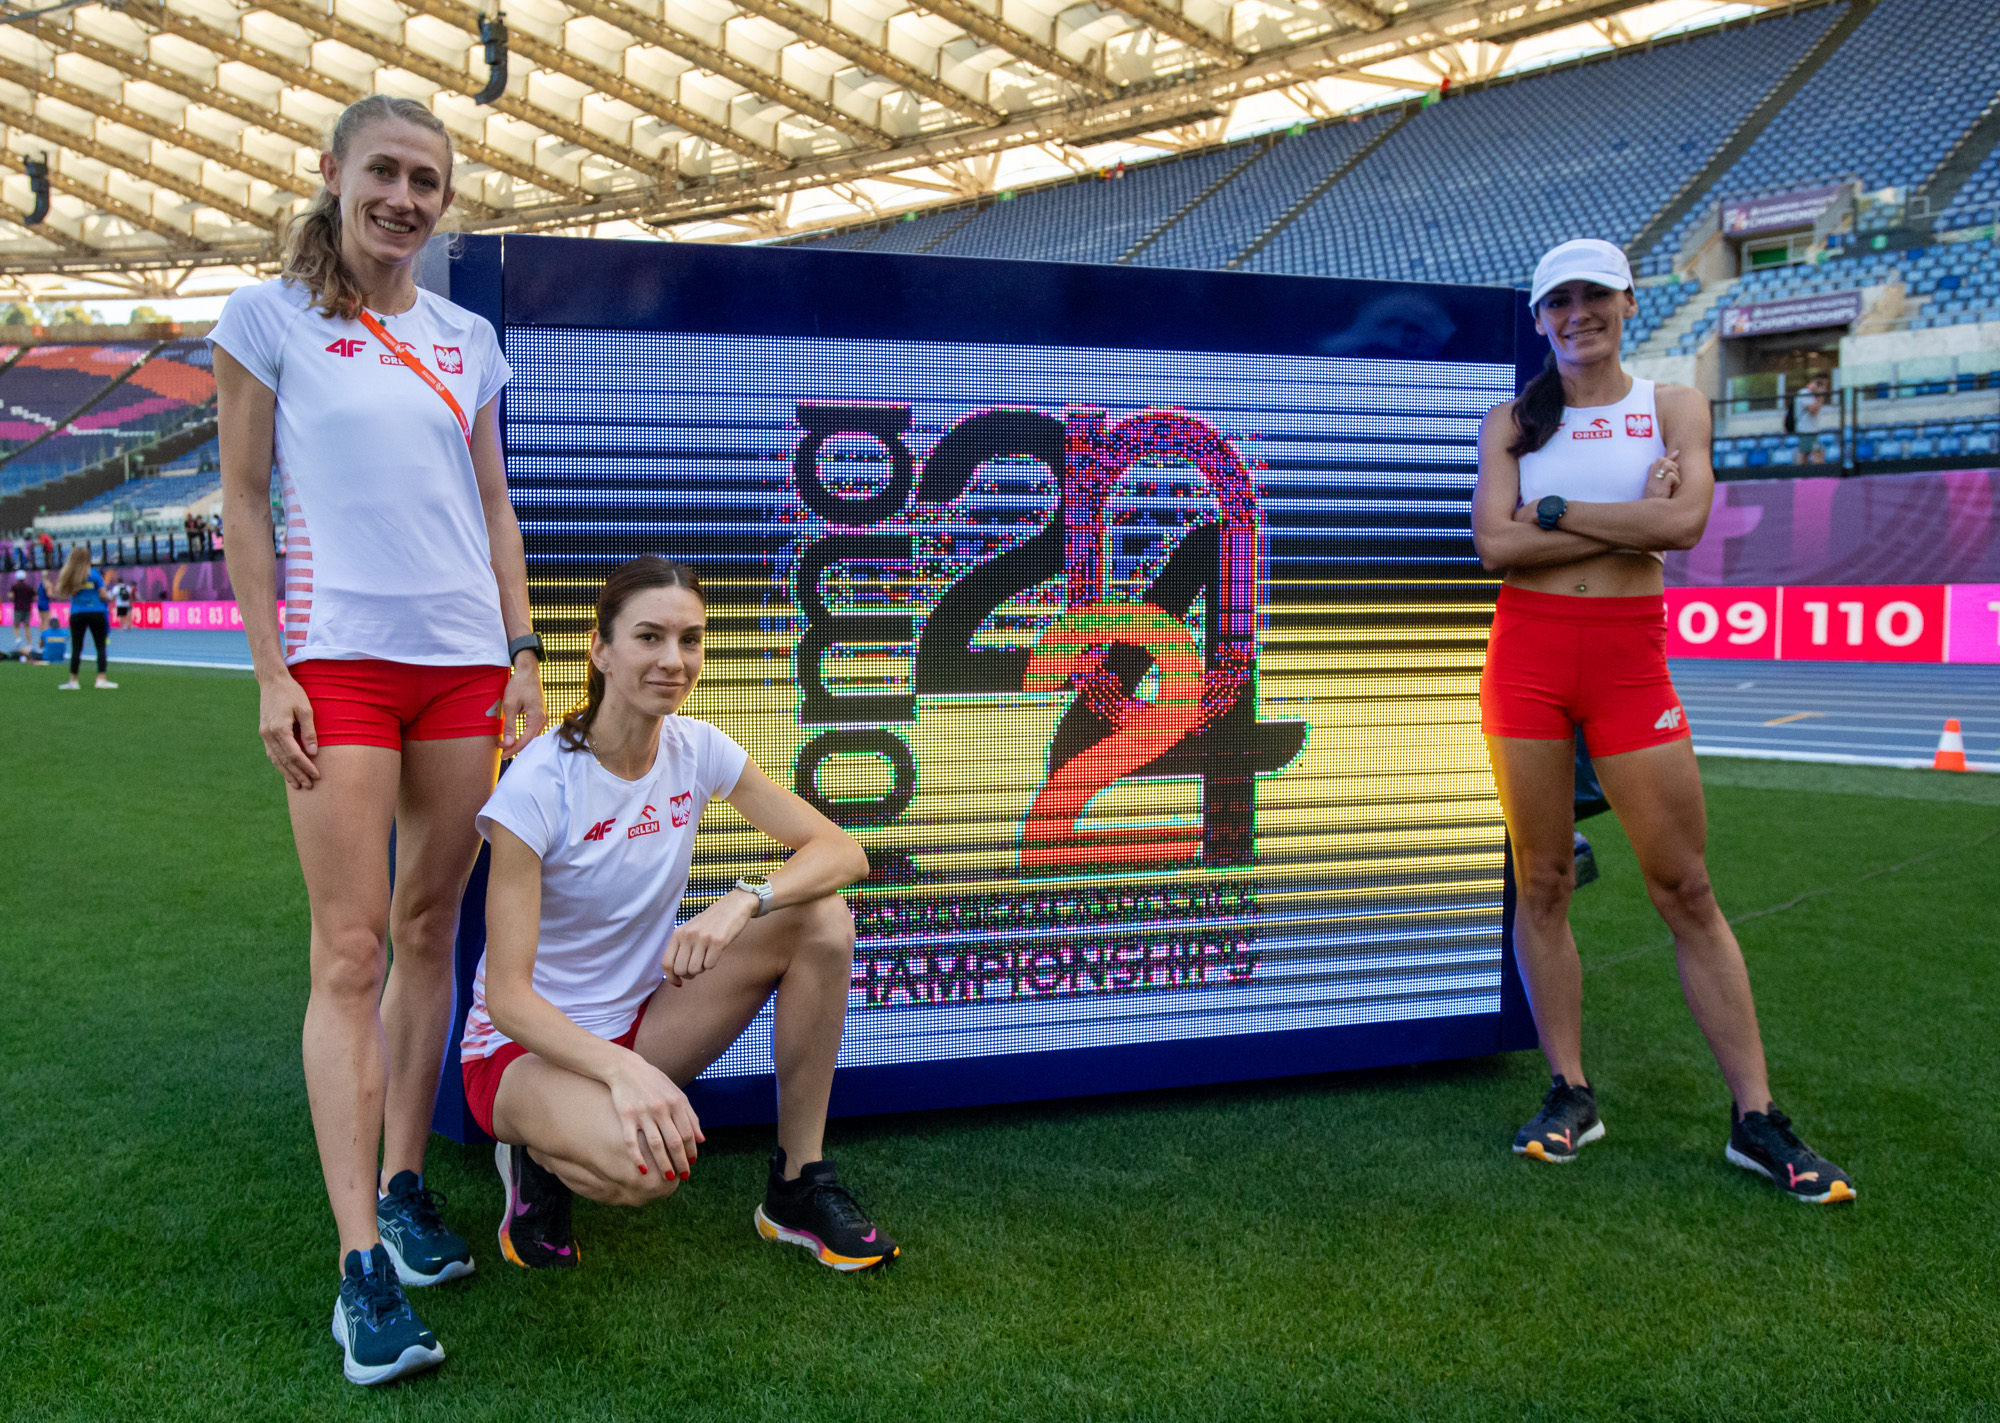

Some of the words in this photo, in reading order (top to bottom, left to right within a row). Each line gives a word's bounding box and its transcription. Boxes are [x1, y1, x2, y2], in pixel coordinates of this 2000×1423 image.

[325, 338, 367, 357] 4F
[1574, 430, 1611, 440] ORLEN
[208, 607, 223, 625] 83
[1664, 601, 1768, 645] 09
[1803, 600, 1924, 647] 110
[1654, 706, 1682, 730] 4F
[583, 817, 617, 842] 4F
[629, 822, 658, 838] ORLEN
[852, 931, 1262, 1006] HAMPIONSHIPS
